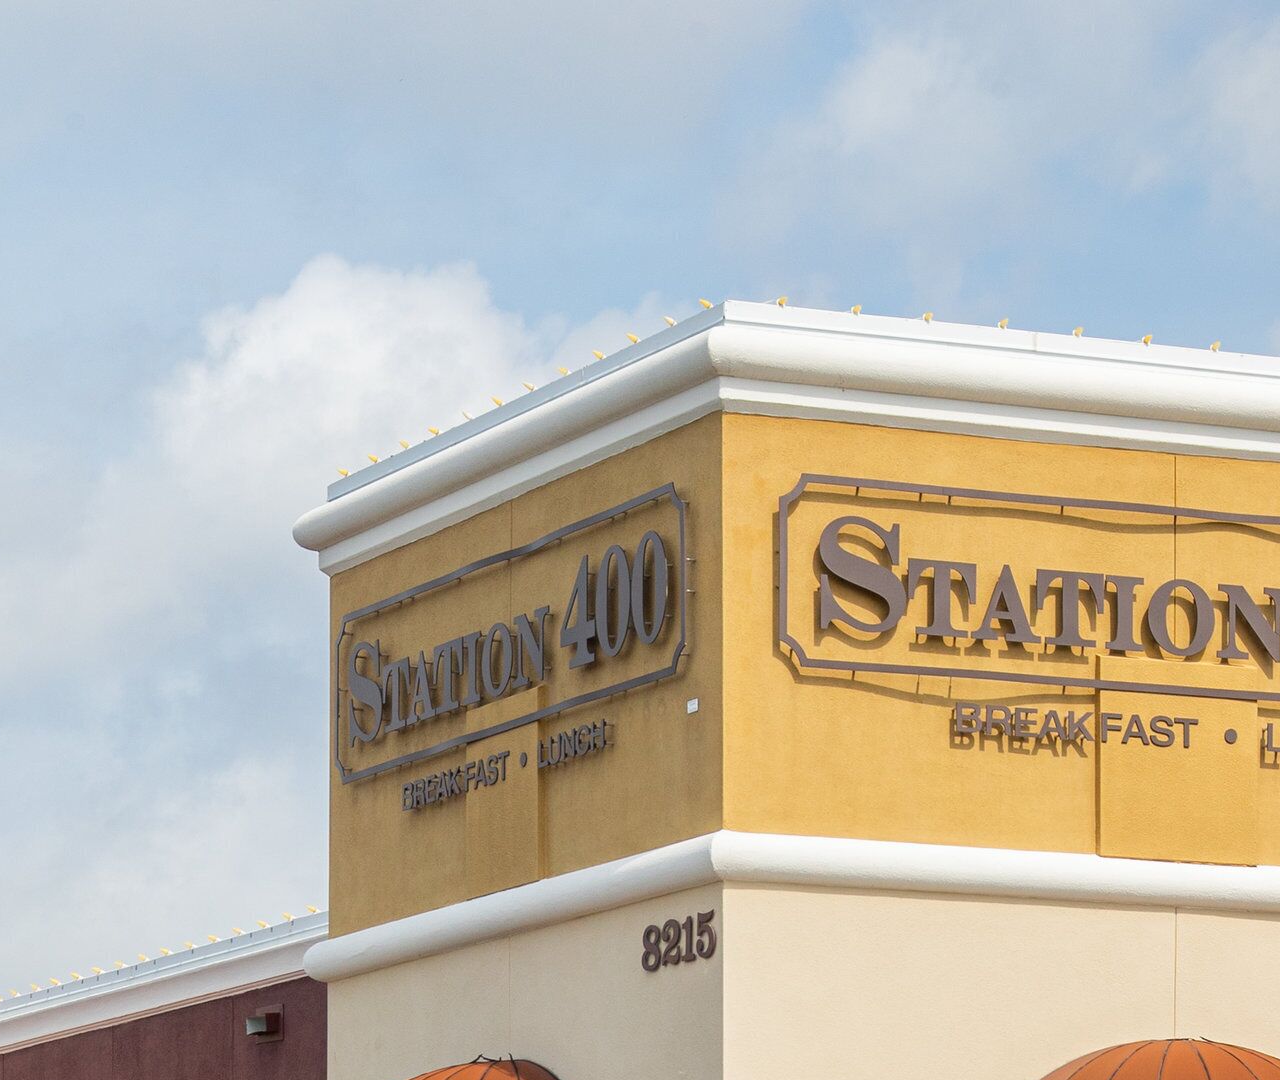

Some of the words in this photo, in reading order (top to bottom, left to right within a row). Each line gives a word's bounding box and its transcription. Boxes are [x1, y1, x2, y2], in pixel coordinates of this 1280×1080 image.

[348, 605, 550, 748] STATION
[560, 530, 668, 670] 400
[954, 702, 1199, 749] BREAKFAST
[401, 750, 510, 813] BREAKFAST
[536, 719, 608, 769] LUNCH
[641, 909, 716, 973] 8215
